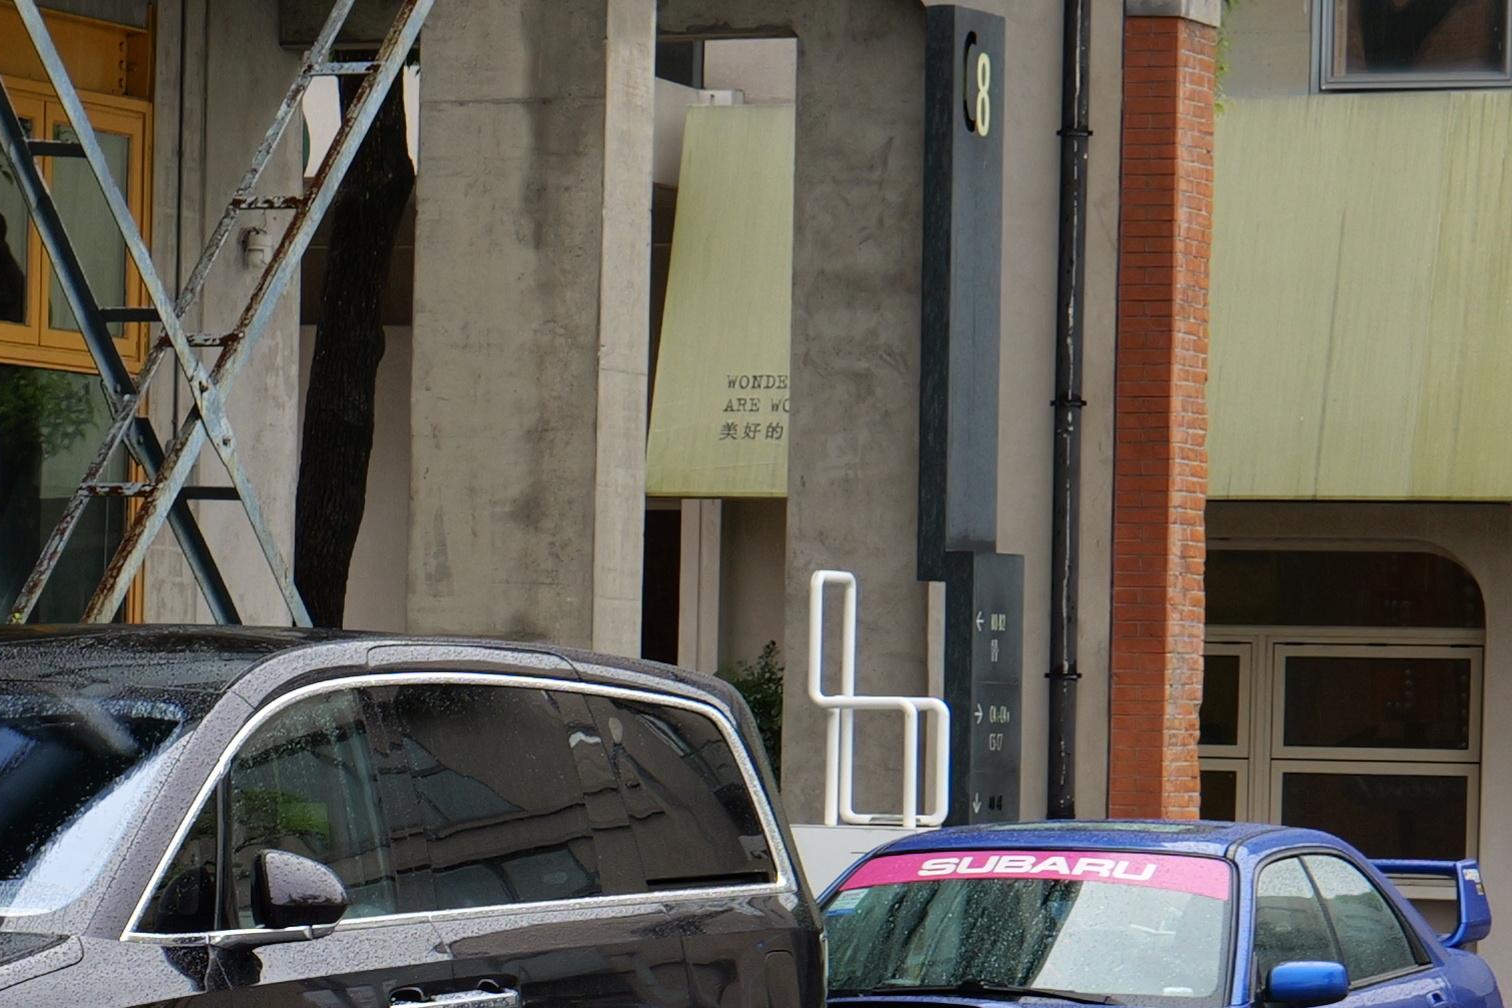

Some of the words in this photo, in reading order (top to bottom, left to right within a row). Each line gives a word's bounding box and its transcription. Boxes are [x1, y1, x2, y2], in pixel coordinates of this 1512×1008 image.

[727, 374, 788, 389] WONDE
[723, 397, 760, 412] ARE
[719, 421, 784, 440] 美好的
[917, 855, 1158, 881] SUBARU
